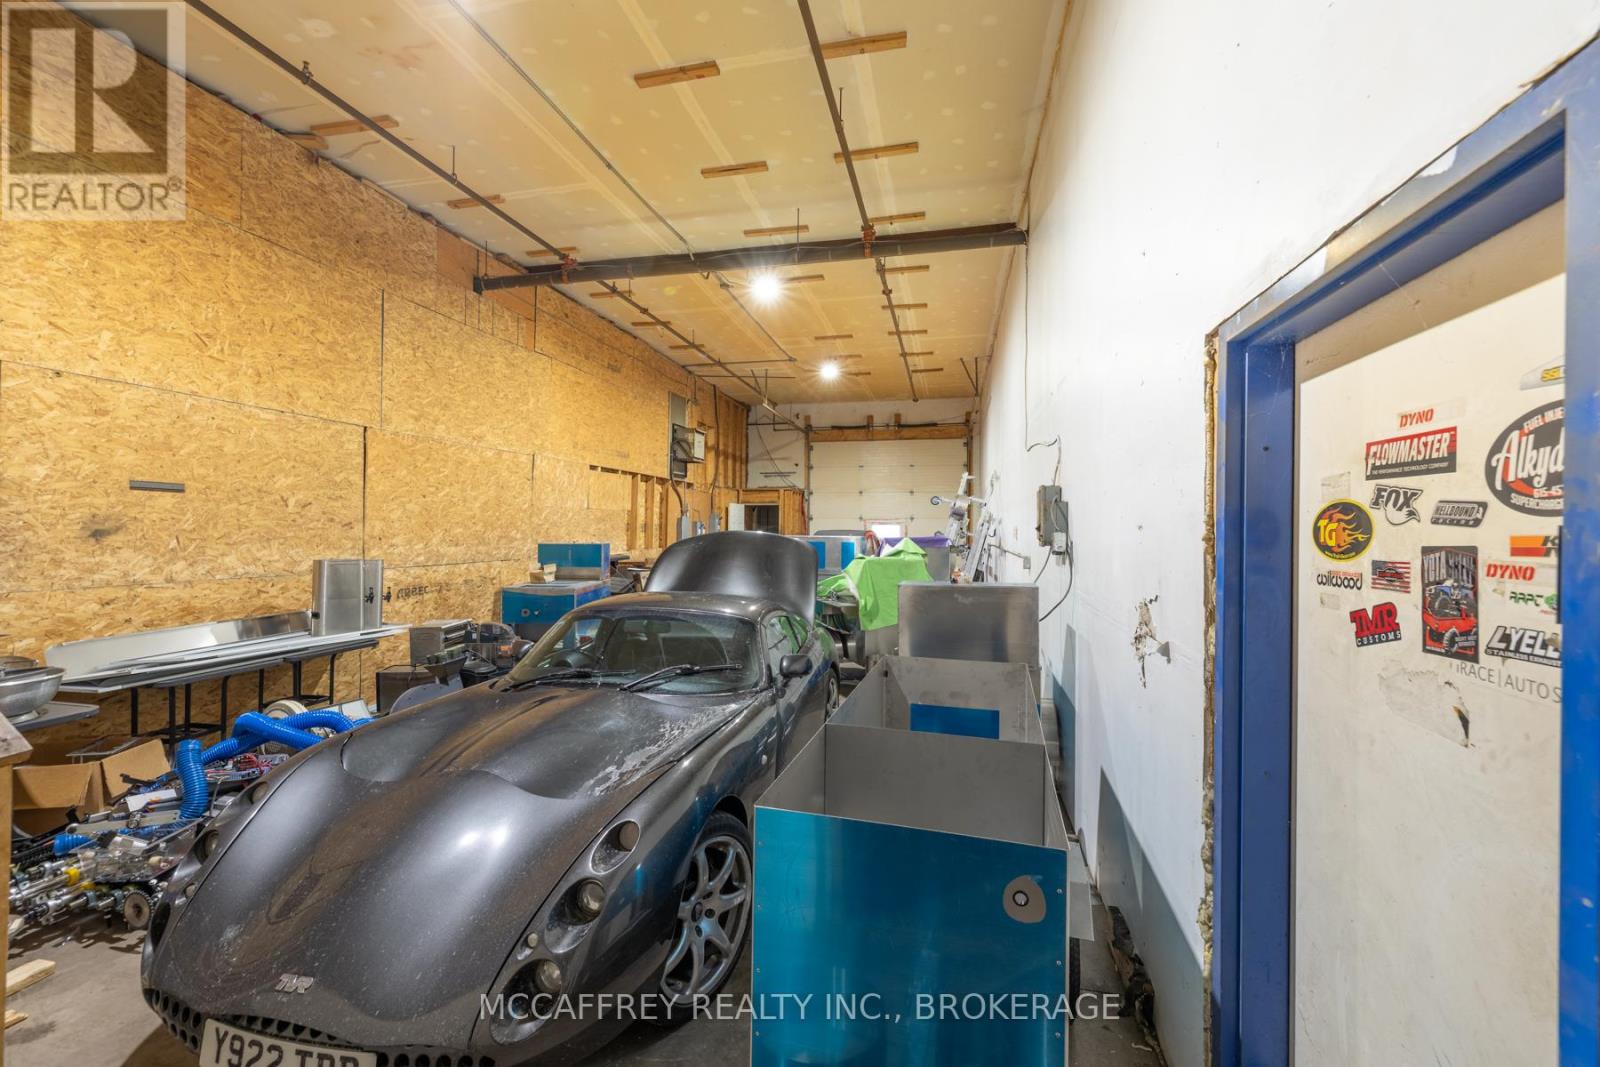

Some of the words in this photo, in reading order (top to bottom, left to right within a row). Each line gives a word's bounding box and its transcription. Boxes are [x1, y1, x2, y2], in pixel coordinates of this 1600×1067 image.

[1399, 408, 1434, 428] DYNO
[1366, 432, 1451, 476] FLOWMASTER
[1372, 487, 1419, 511] FOX
[1317, 570, 1363, 590] wilwood
[1486, 564, 1535, 581] DYNO
[1349, 602, 1400, 637] TMR
[1356, 630, 1402, 646] CUSTOMS
[275, 974, 313, 993] TVR
[214, 1027, 283, 1067] Y922
